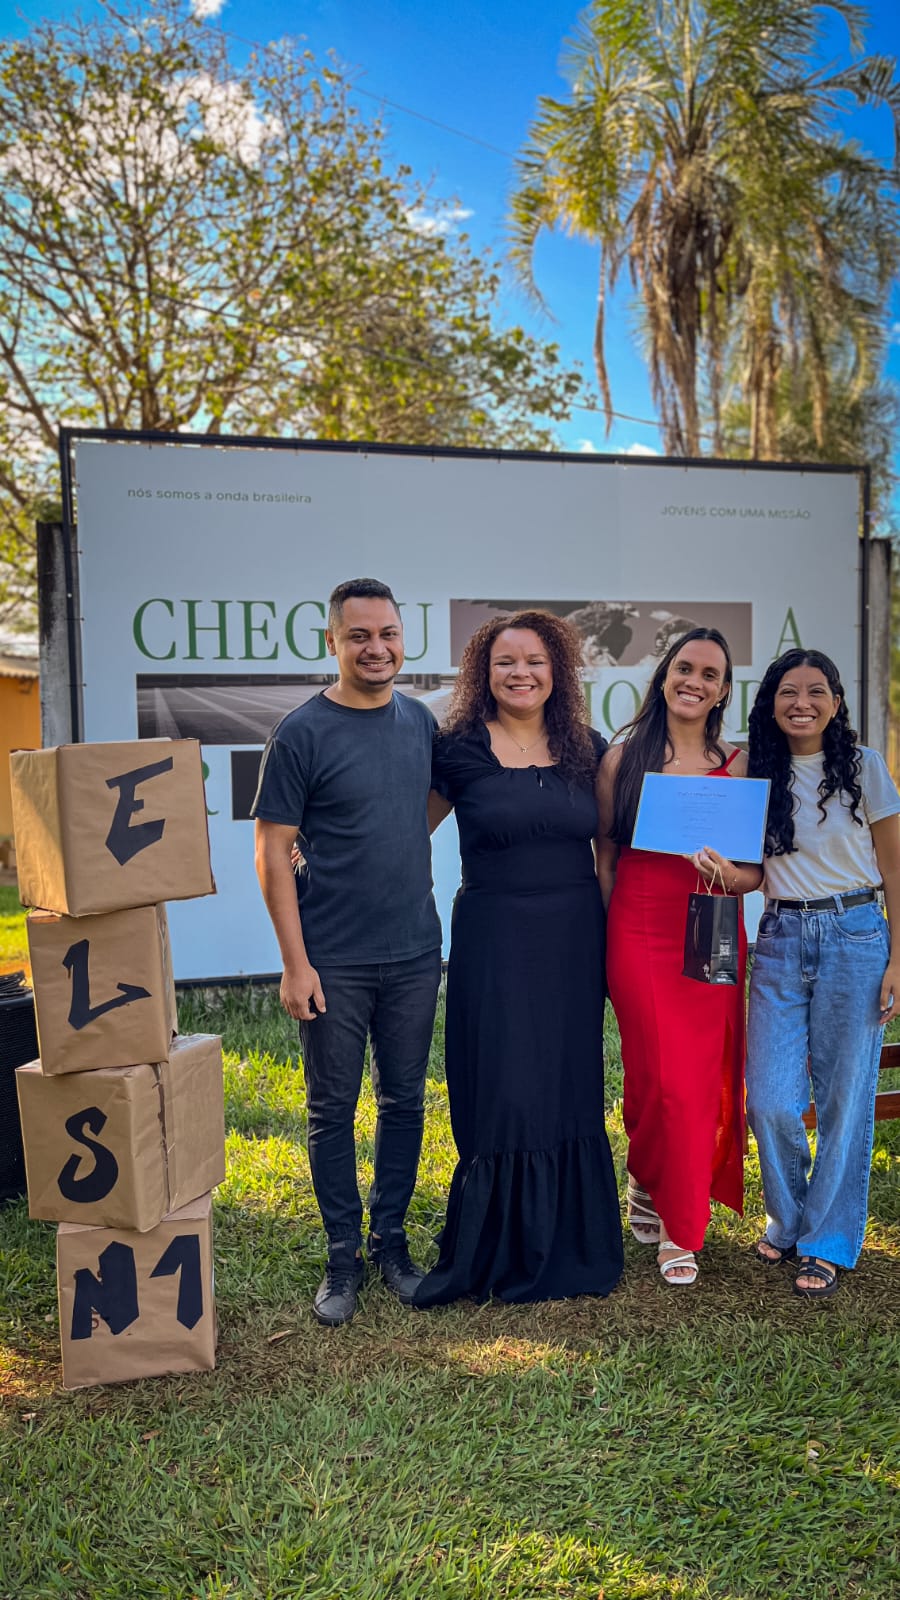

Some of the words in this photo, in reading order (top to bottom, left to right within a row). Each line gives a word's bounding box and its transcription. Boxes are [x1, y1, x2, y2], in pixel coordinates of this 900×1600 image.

[127, 488, 152, 498] nós
[156, 490, 200, 500] somos
[204, 492, 212, 500] a
[216, 491, 249, 501] onda
[253, 492, 312, 503] brasileira
[661, 505, 706, 517] JOVENS
[709, 507, 737, 517] COM
[739, 508, 765, 518] UMA
[768, 507, 811, 519] MISSÃO
[132, 598, 433, 661] CHEGU
[772, 606, 803, 659] A
[58, 1106, 119, 1203] S
